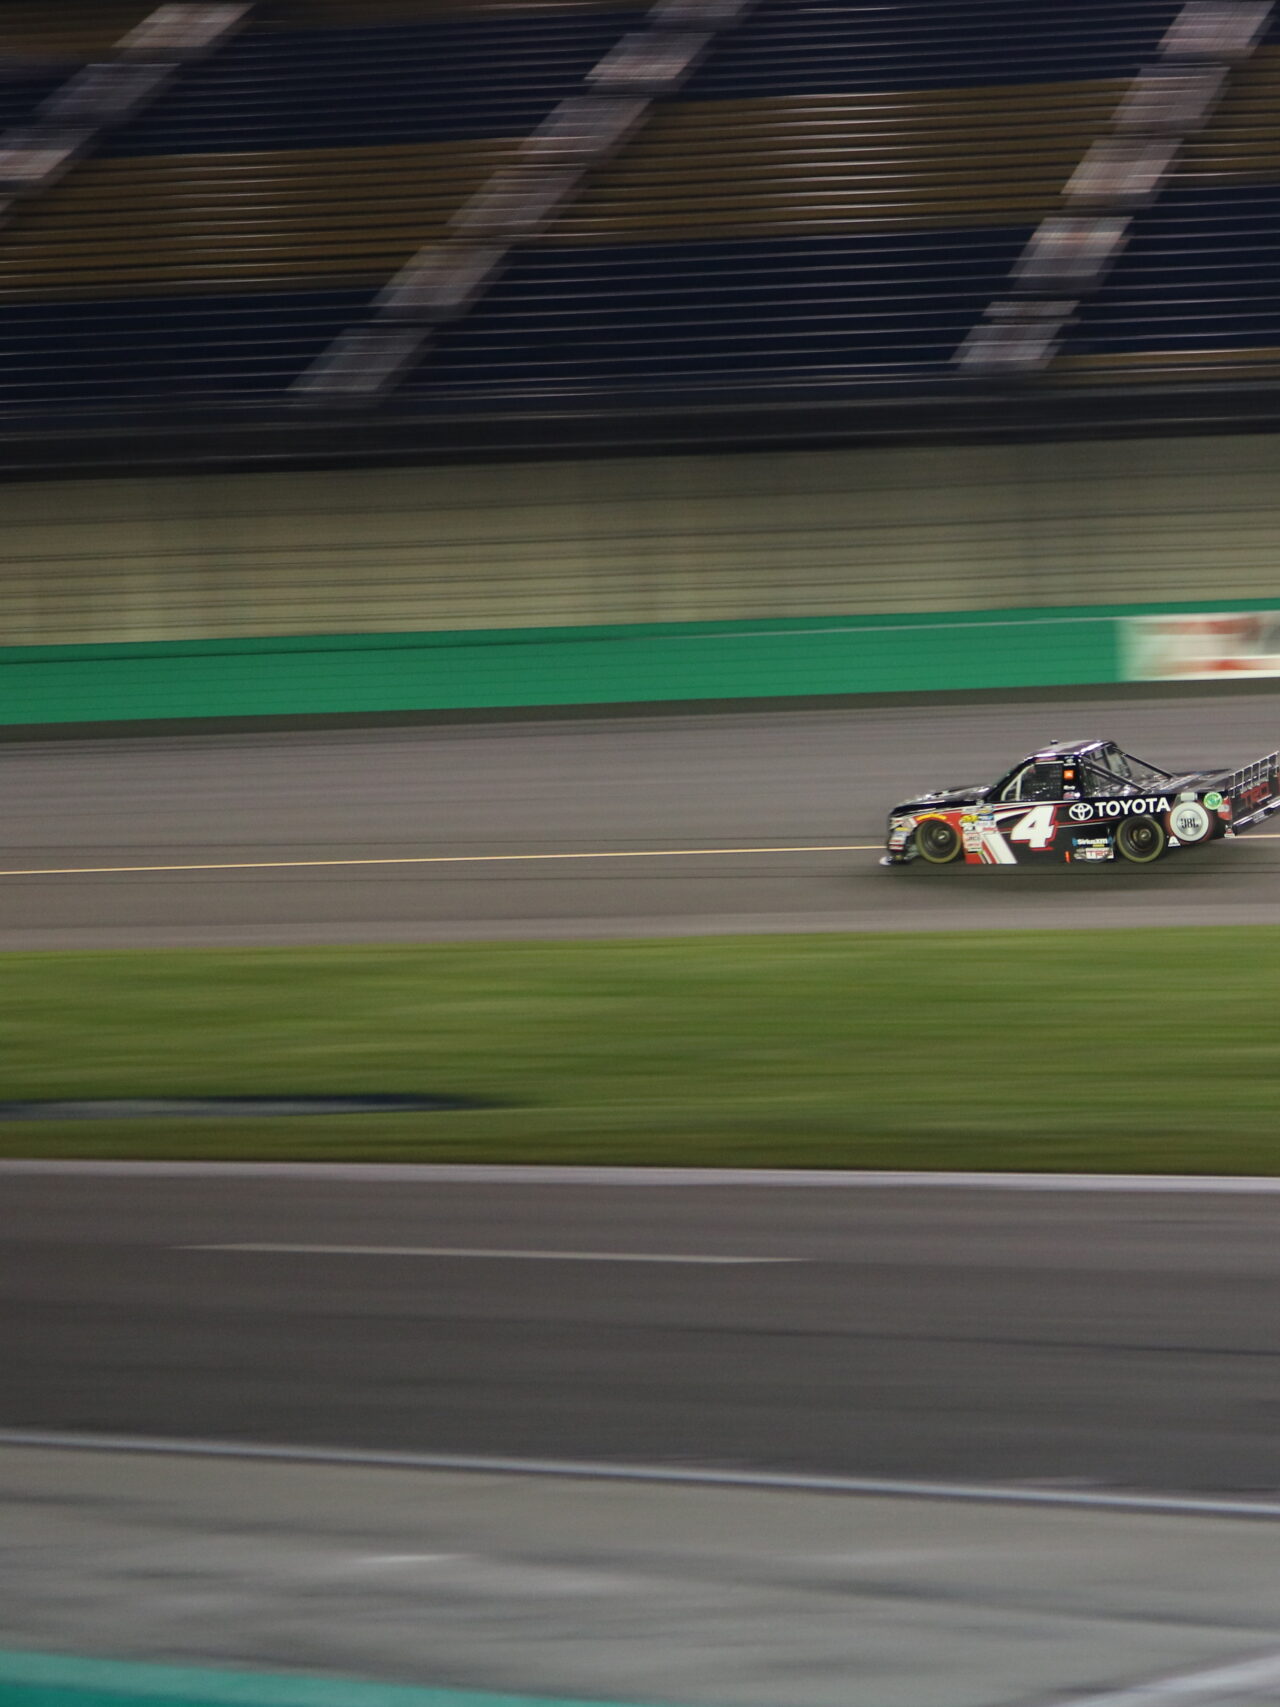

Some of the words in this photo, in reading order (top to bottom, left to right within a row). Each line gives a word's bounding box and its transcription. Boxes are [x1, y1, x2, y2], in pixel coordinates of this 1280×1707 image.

[1094, 797, 1171, 817] TOYOTA
[1010, 805, 1056, 850] 4
[1181, 817, 1199, 829] JBL
